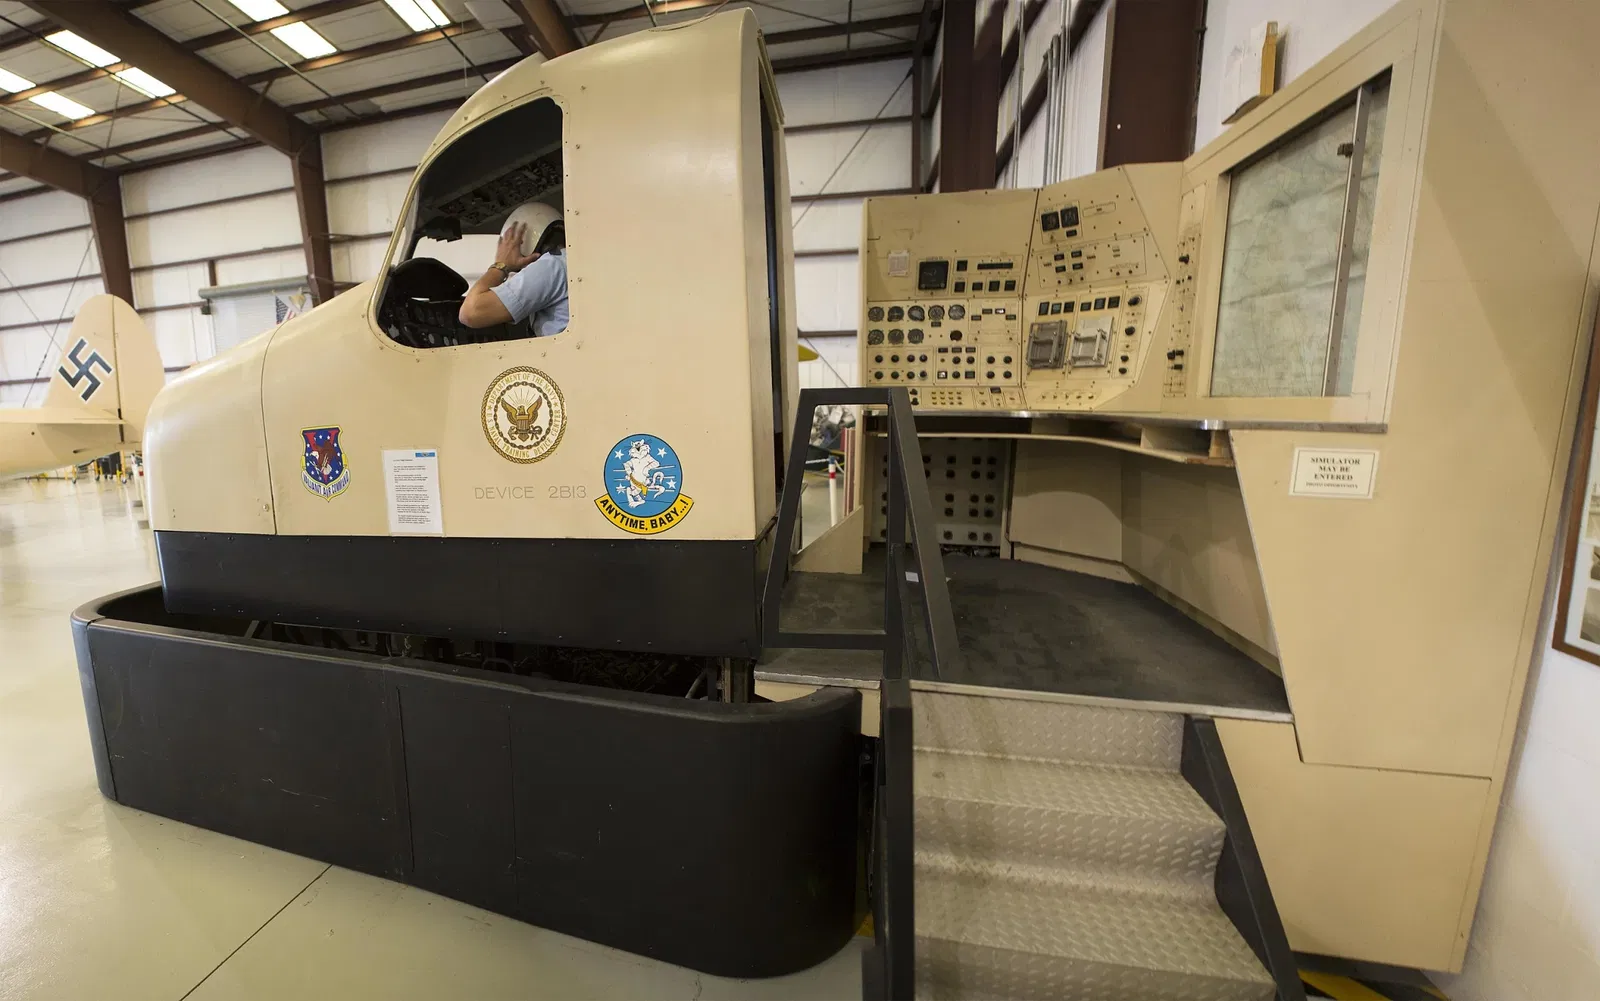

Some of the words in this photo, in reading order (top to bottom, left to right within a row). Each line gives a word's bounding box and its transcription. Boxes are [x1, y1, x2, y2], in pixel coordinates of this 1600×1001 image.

[490, 373, 521, 404] DEPARTMENT
[522, 373, 531, 381] OF
[532, 374, 545, 386] THE
[544, 384, 558, 402] NAVY
[489, 426, 502, 446] NAVAL
[501, 443, 530, 459] TRAINING
[533, 437, 553, 456] DEVICE
[551, 409, 562, 438] CENTER
[1311, 457, 1360, 465] SIMULATOR
[1319, 465, 1337, 473] MAY
[1314, 473, 1354, 481] ENTERED
[474, 486, 535, 500] DEVICE
[599, 498, 649, 531] ANYTIME,
